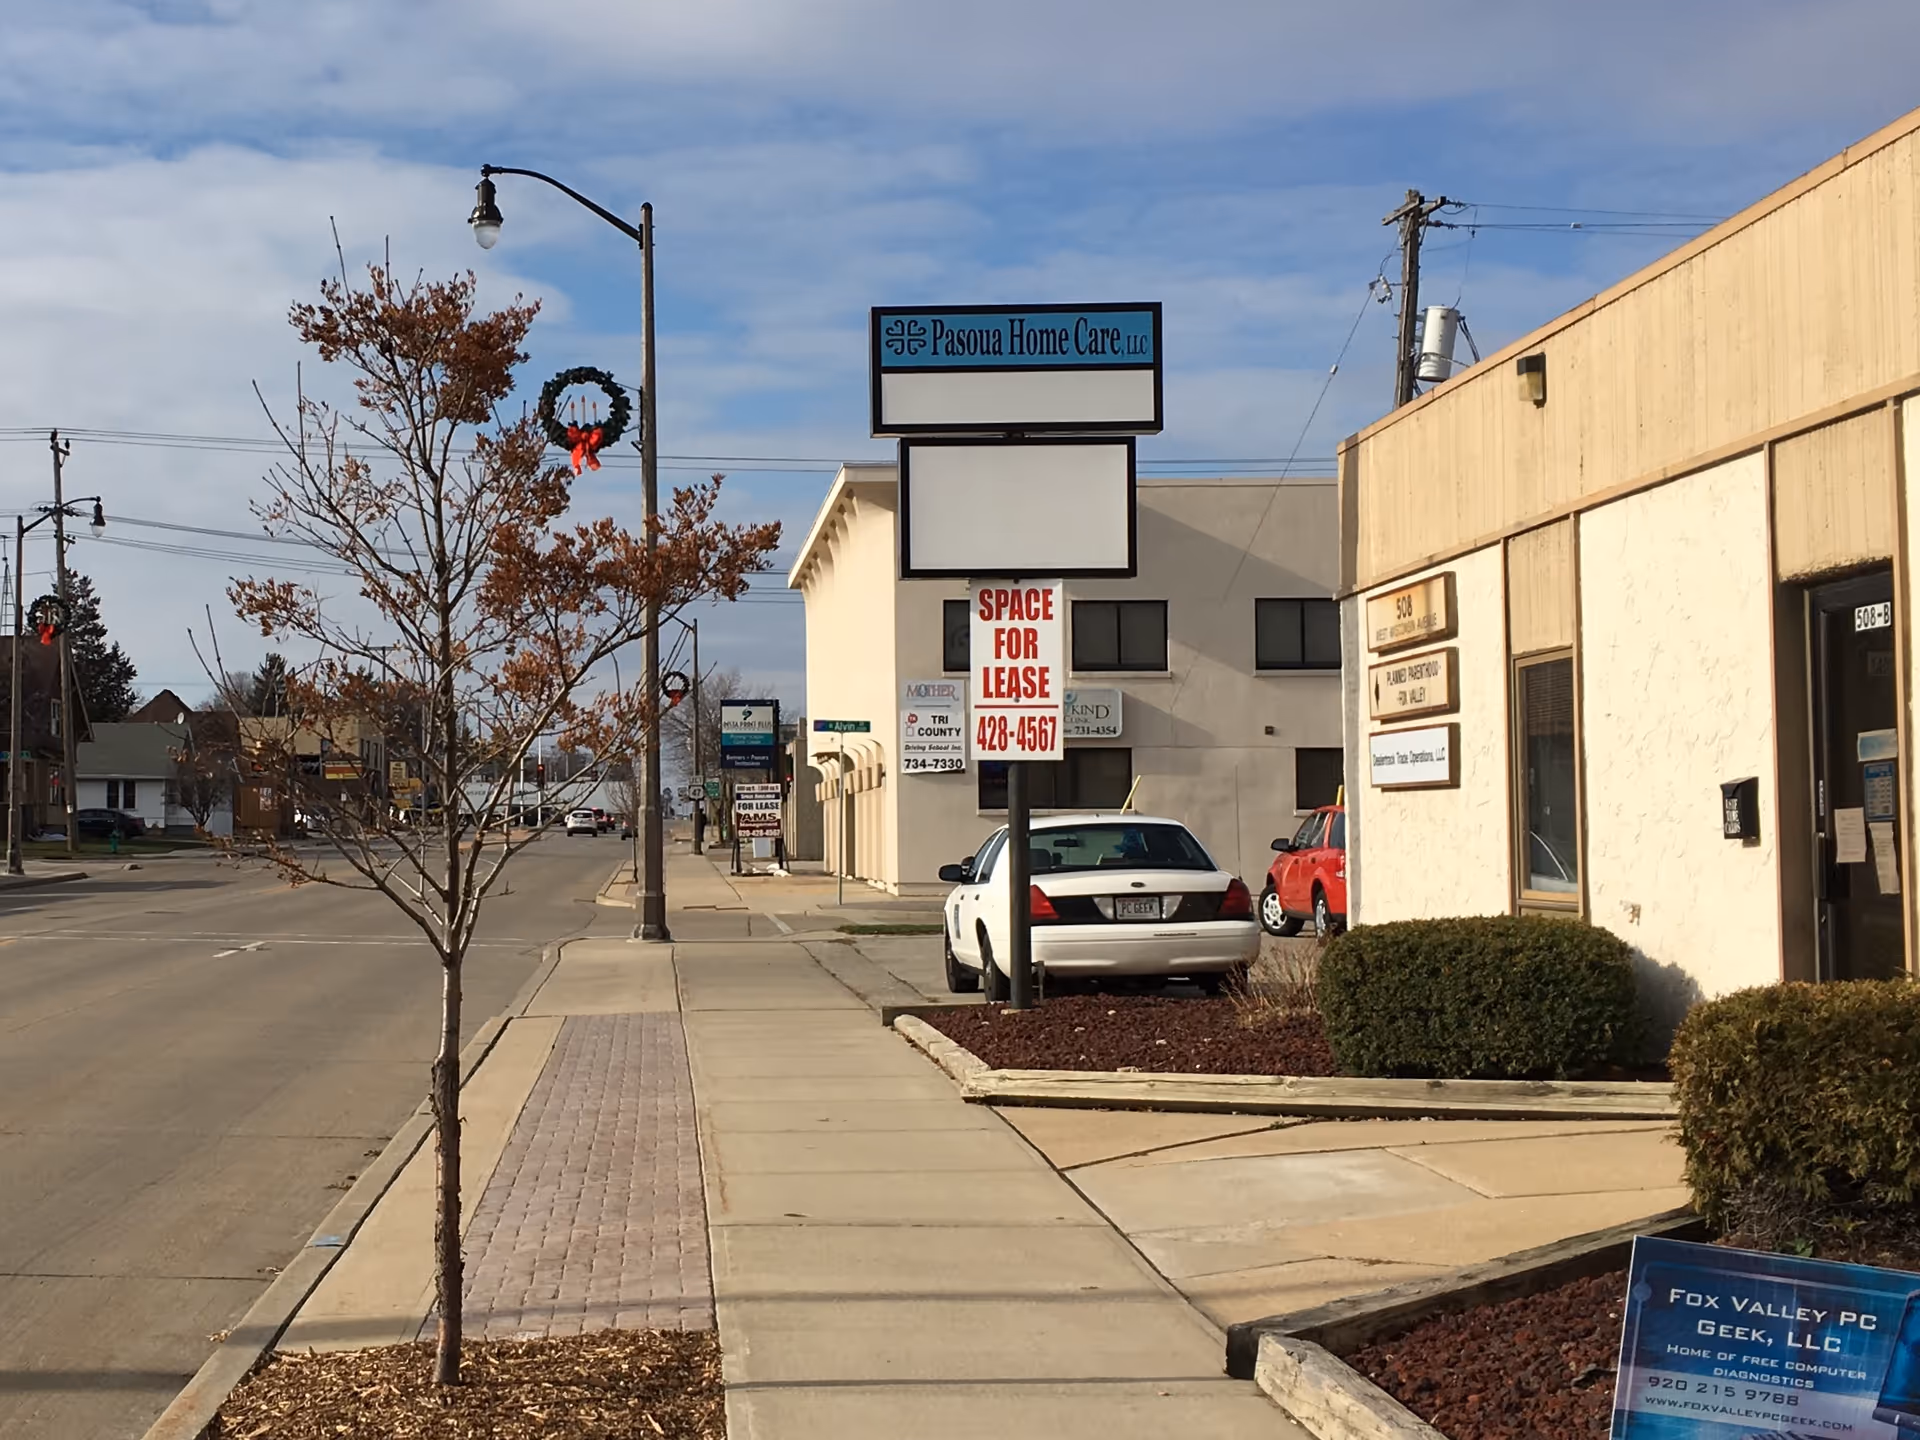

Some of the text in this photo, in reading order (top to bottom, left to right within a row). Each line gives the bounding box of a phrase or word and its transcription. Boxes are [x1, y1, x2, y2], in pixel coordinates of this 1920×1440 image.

[931, 318, 1003, 357] Pasoua
[1008, 318, 1069, 356] Home
[1126, 335, 1148, 355] LLC
[979, 588, 1053, 621] SPACE
[1396, 594, 1413, 620] 508
[1856, 603, 1890, 629] 508-B
[994, 627, 1038, 660] FOR
[906, 683, 959, 701] MOTHER
[983, 666, 1049, 699] LEASE
[834, 721, 856, 731] Alvin
[917, 727, 961, 737] COUNTY
[931, 715, 949, 725] TRI
[977, 715, 1056, 751] 428-4567
[1074, 725, 1117, 735] 731-4354
[904, 744, 926, 752] Driving
[904, 759, 963, 769] 734-7330
[738, 801, 780, 810] FOR LEASE
[742, 812, 777, 821] AMS
[1121, 903, 1154, 914] PC GEEK
[1669, 1288, 1878, 1331] FOX VALLEY PC
[1697, 1319, 1841, 1353] GEEK, LLC
[1666, 1343, 1867, 1381] HOME OF FREE COMPUTER
[1713, 1367, 1815, 1389] DIAGNOSTICS
[1648, 1376, 1800, 1407] 920 215 9788
[1644, 1395, 1854, 1432] WWW.FOXVALLEYPCGEEK.COM
